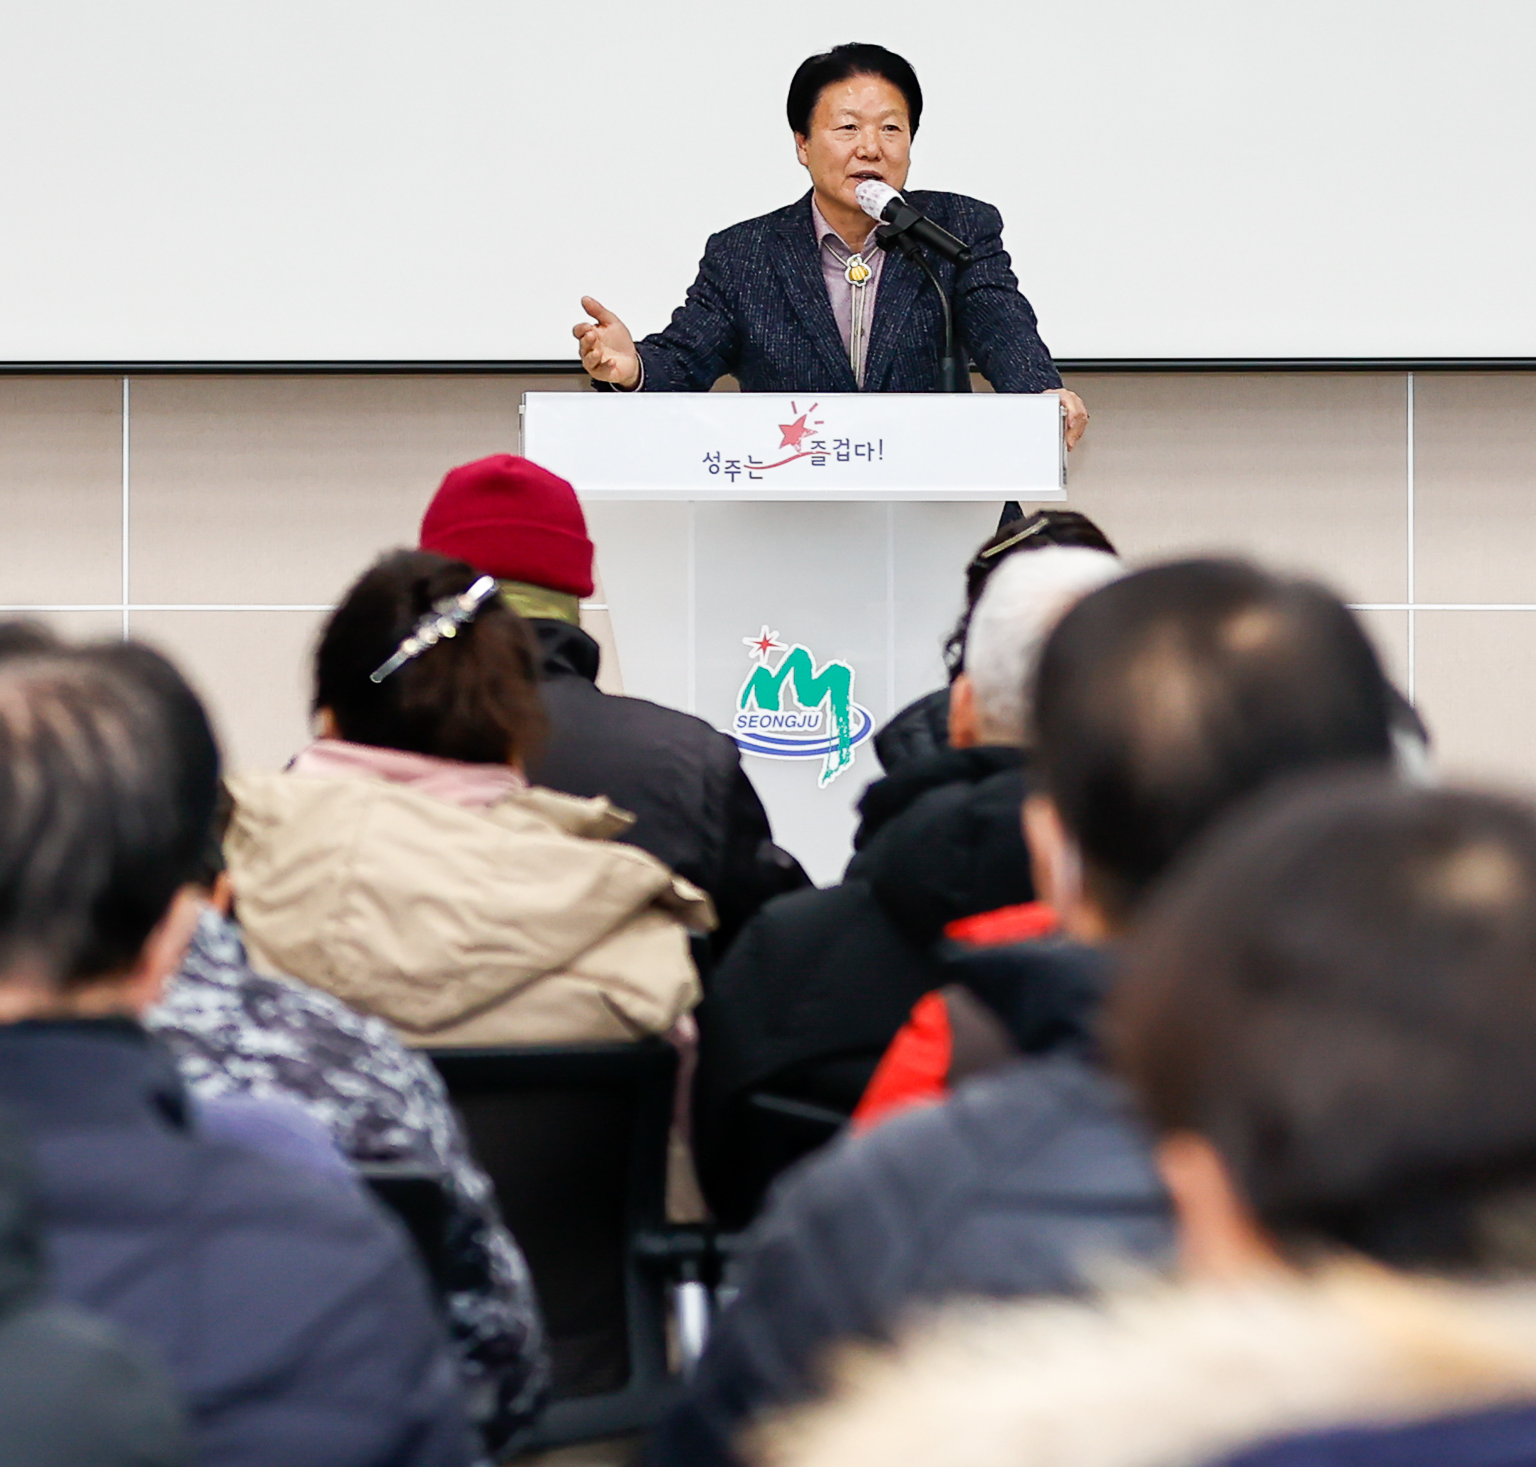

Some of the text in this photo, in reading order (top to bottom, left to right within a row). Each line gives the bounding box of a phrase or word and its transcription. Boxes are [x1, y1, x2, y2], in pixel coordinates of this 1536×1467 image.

[701, 437, 885, 484] 성주는 즐겁다!
[735, 713, 820, 730] SEONGJU
